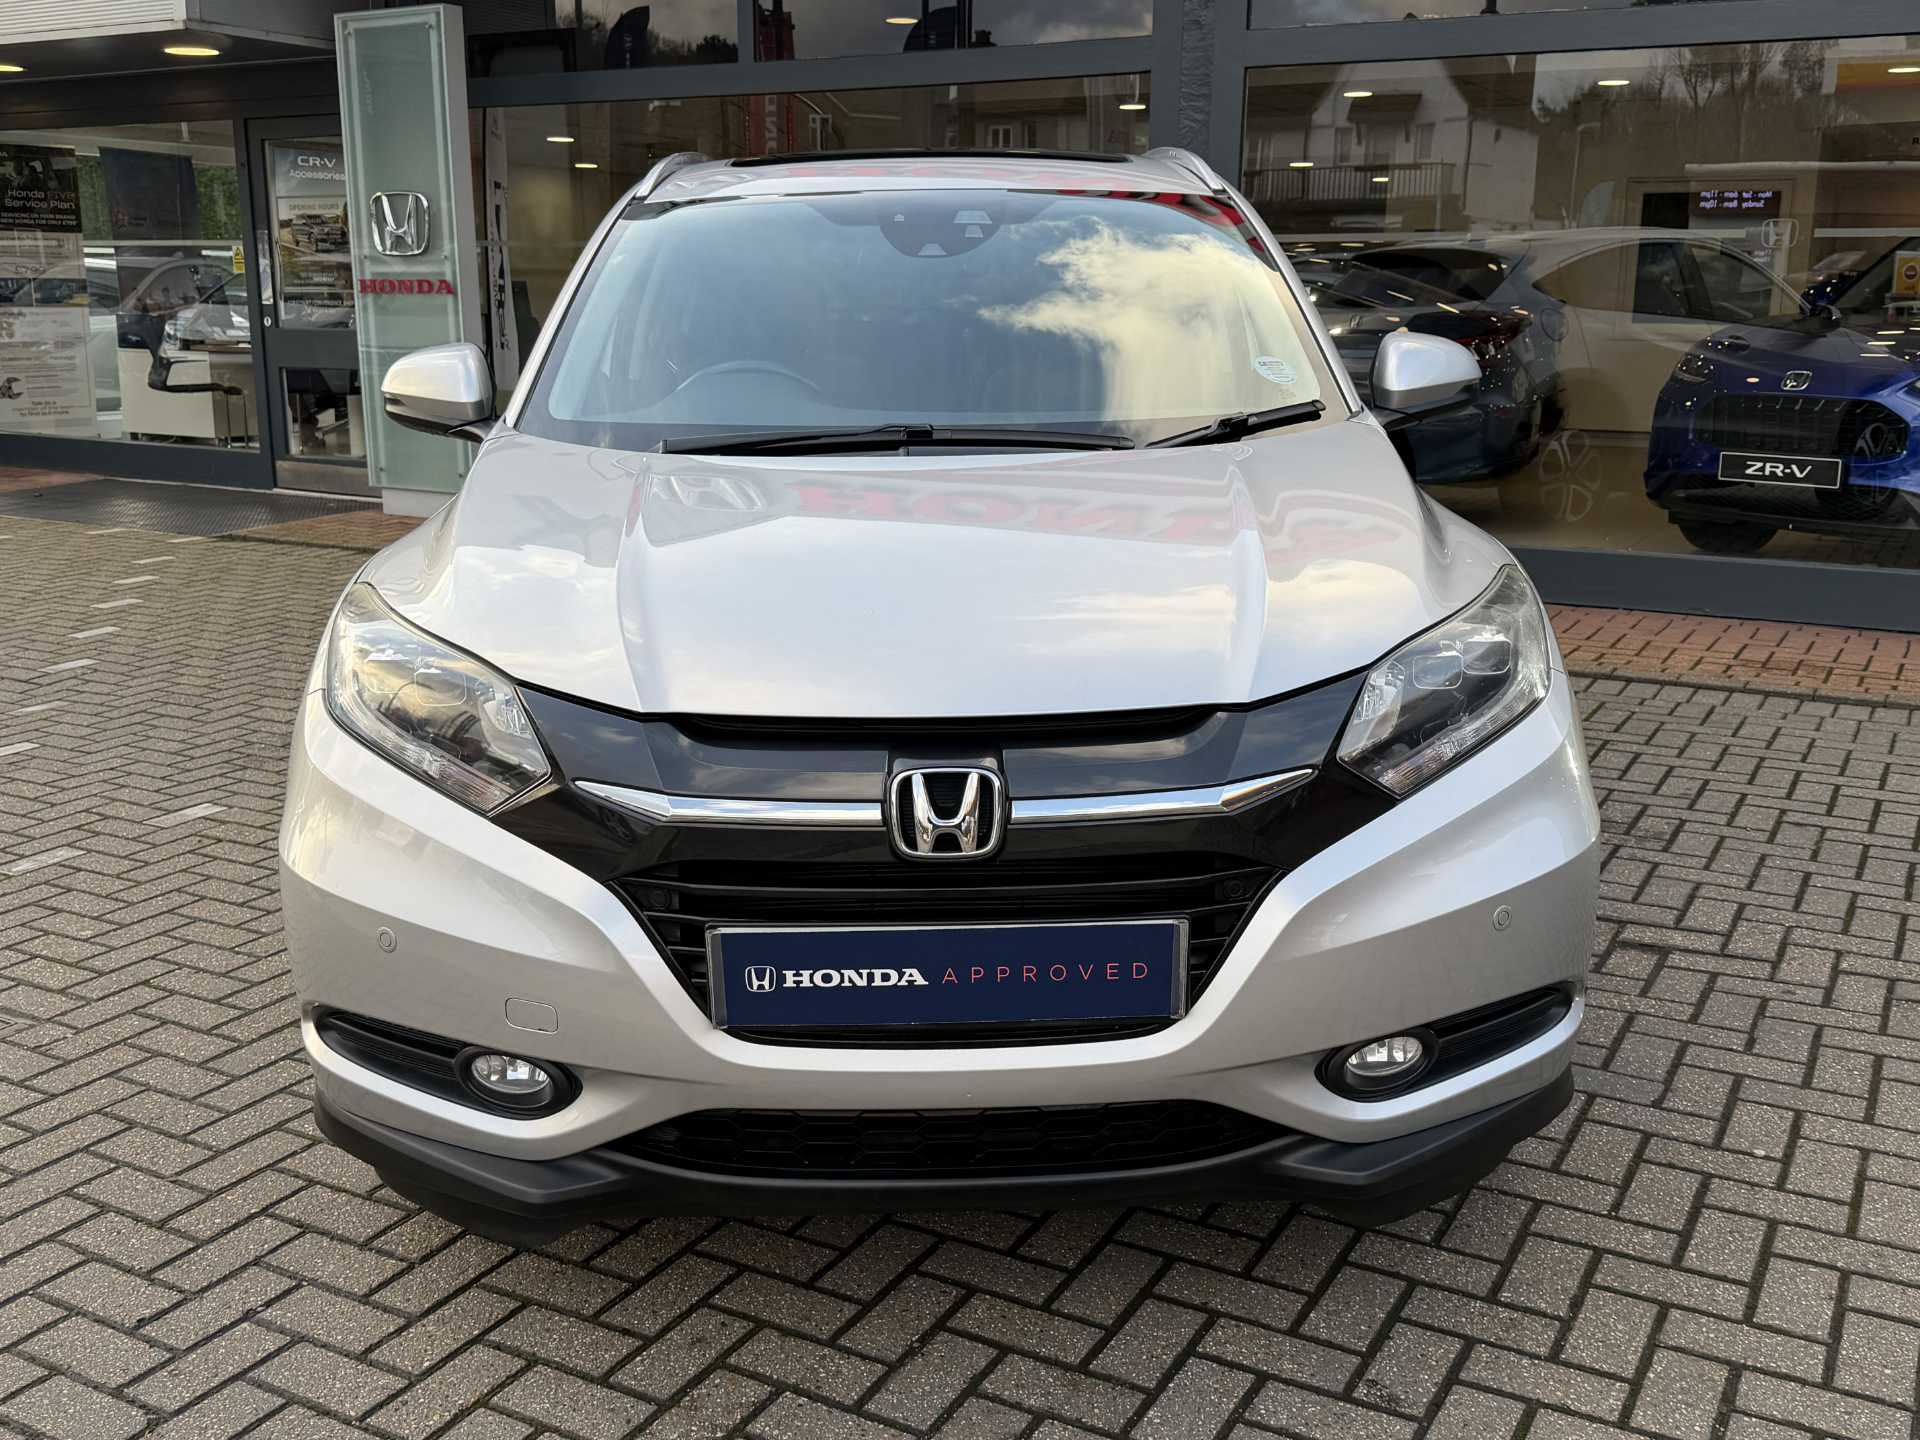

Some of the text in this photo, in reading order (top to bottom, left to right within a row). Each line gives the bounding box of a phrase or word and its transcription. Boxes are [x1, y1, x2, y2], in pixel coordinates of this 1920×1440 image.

[8, 189, 45, 199] Honda
[5, 198, 76, 209] Service Plan
[358, 278, 455, 295] HONDA
[1745, 461, 1812, 478] ZR-V
[782, 962, 1148, 988] HONDA APPROVED
